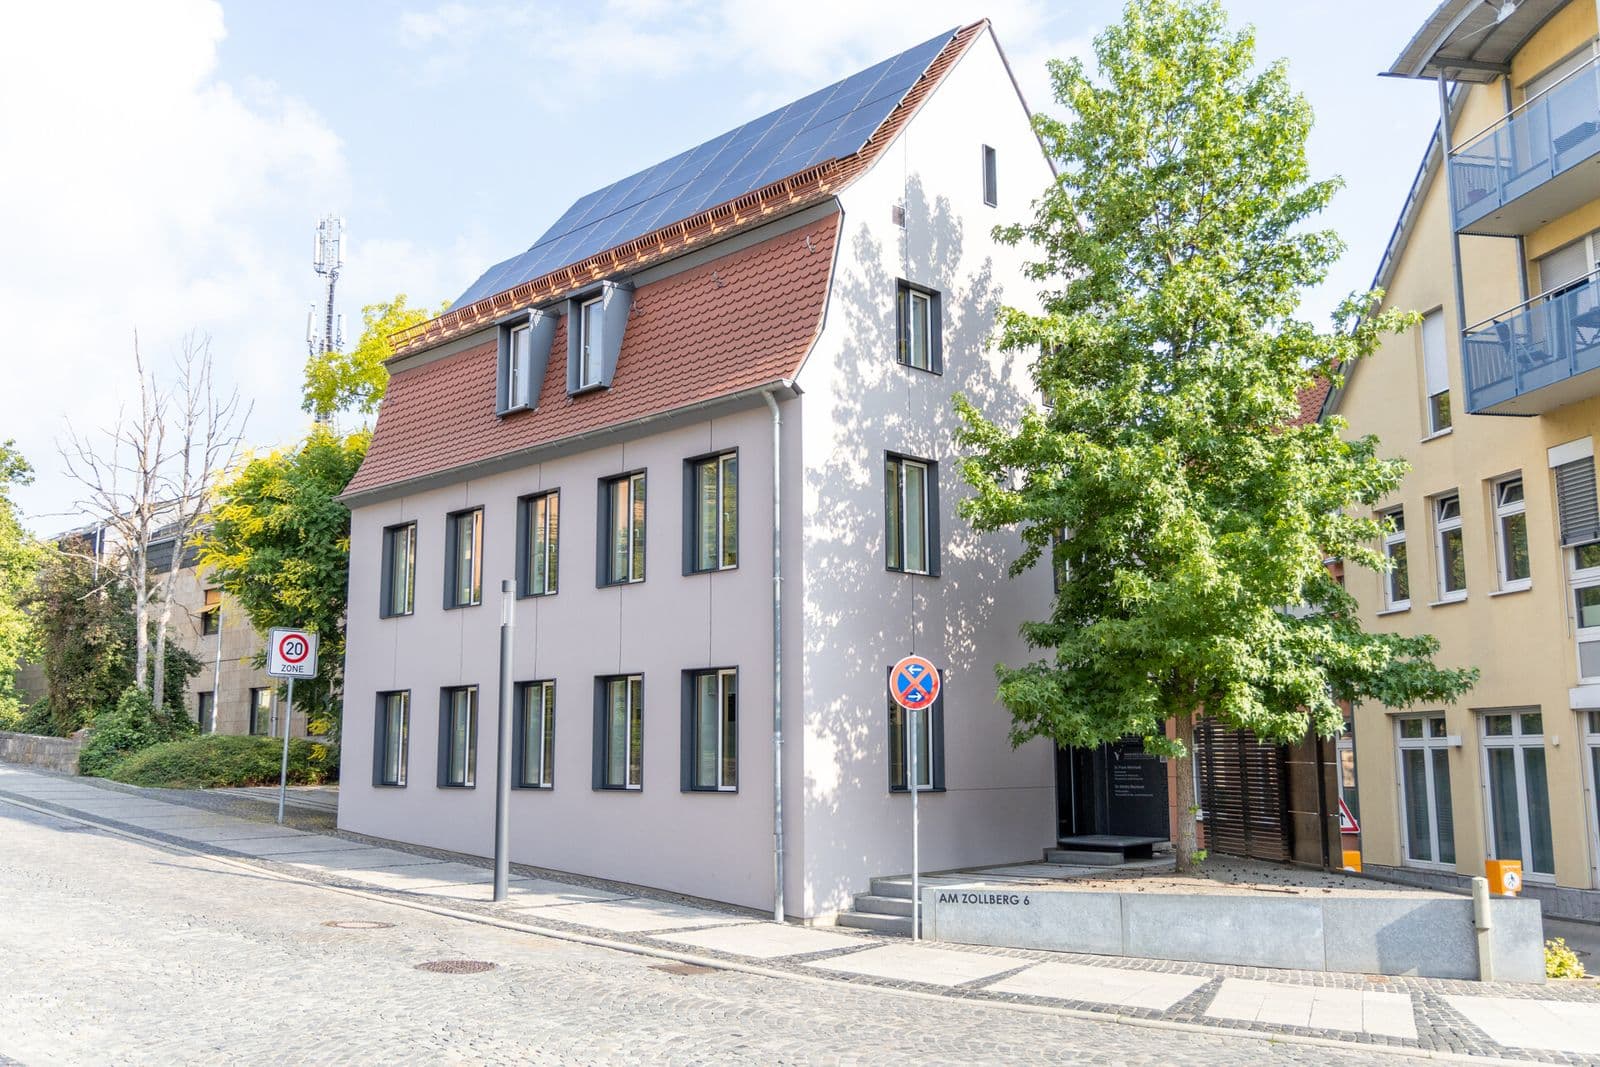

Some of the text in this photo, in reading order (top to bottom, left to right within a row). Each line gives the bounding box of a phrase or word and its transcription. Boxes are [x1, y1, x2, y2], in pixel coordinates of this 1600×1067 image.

[286, 642, 303, 655] 20
[281, 664, 304, 673] ZONE
[939, 893, 1030, 905] AM ZOLLBERG 6
